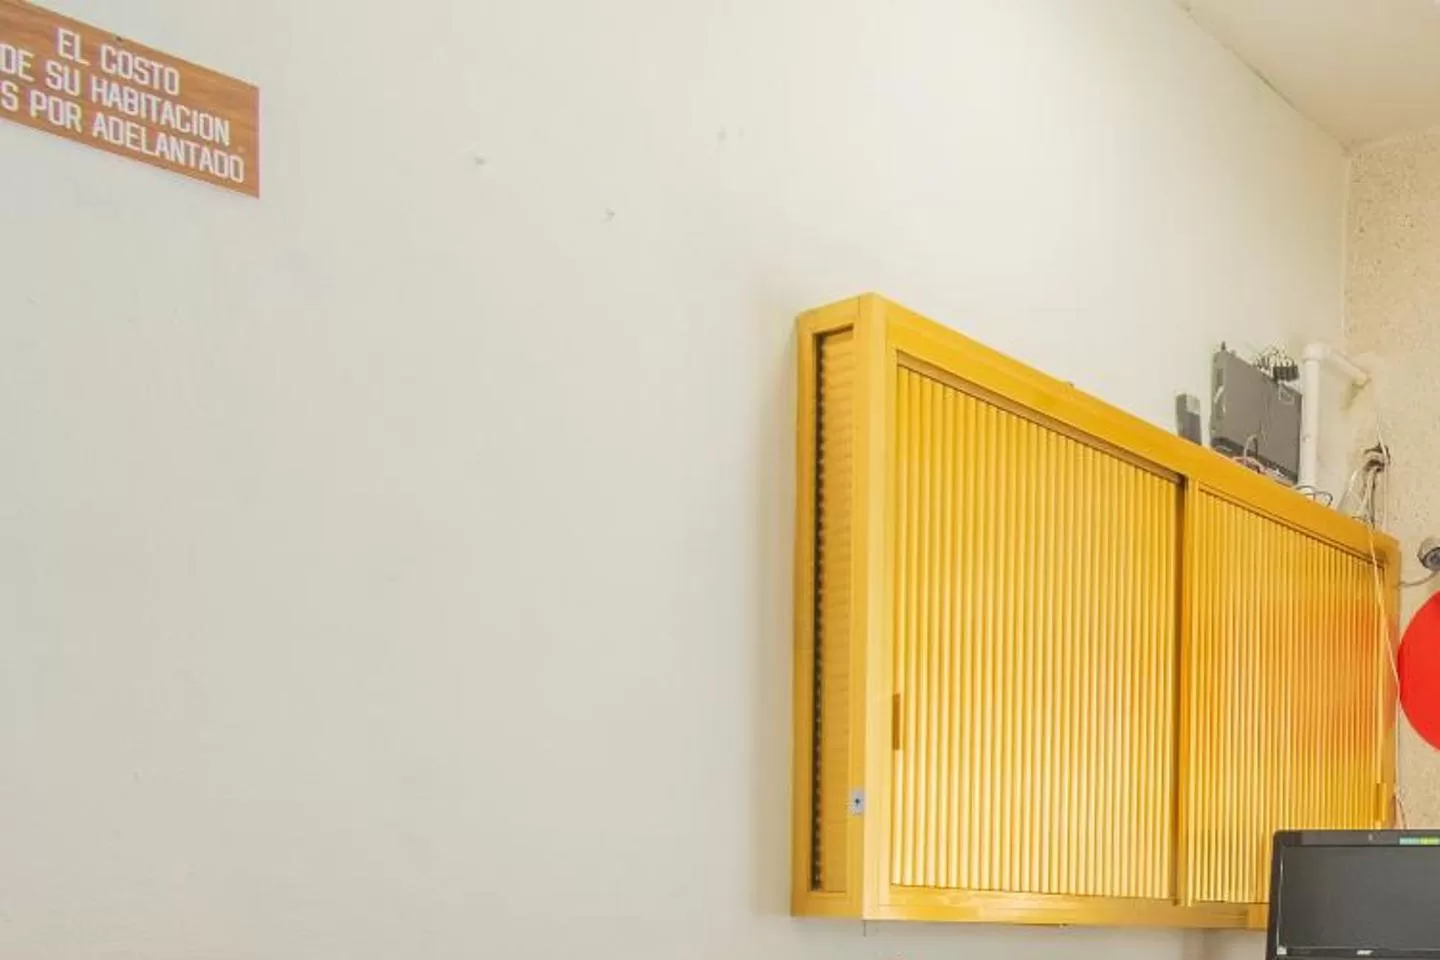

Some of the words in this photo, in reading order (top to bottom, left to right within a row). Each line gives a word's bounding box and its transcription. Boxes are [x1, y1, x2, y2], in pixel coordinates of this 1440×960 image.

[0, 43, 35, 83] DE
[45, 60, 81, 97] SU
[90, 74, 231, 147] HABITACION
[57, 27, 90, 67] EL
[100, 44, 181, 97] COSTO
[30, 88, 83, 133] POR
[92, 111, 245, 183] ADELANTADO
